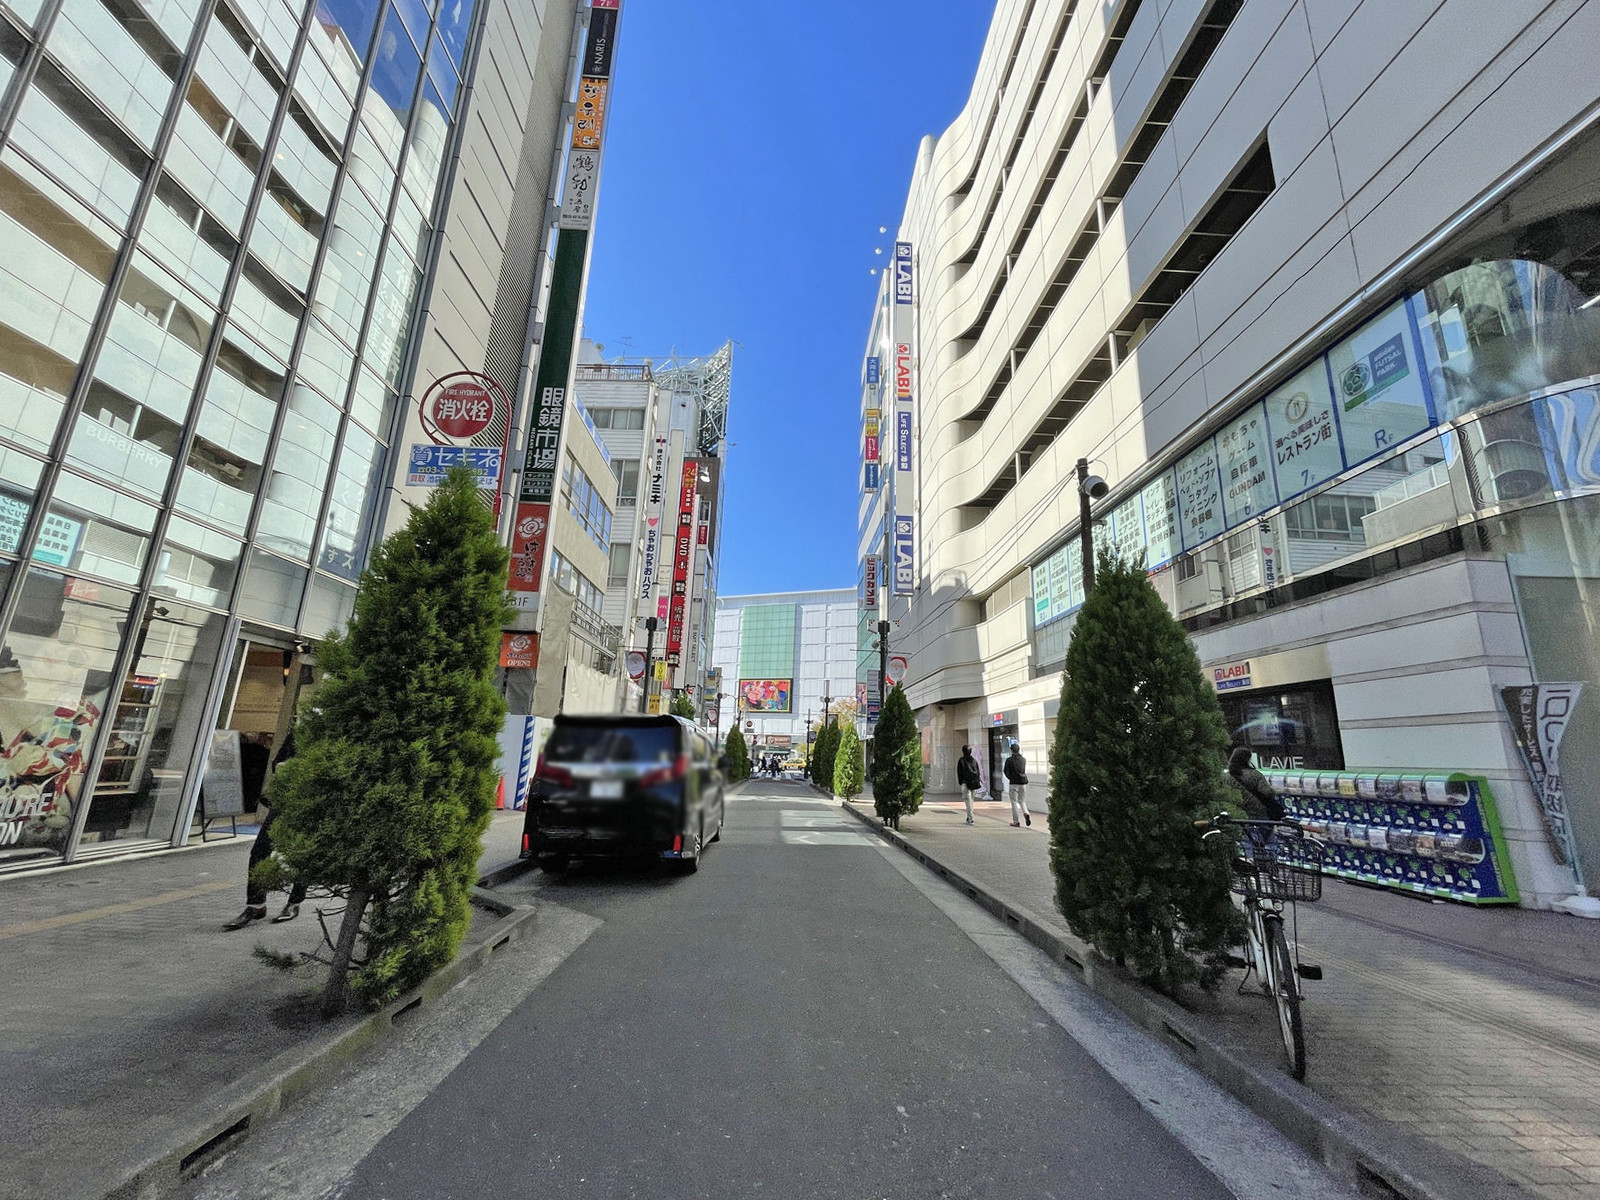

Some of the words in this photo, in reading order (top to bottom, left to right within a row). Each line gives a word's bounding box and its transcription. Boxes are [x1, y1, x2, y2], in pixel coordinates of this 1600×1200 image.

[594, 38, 606, 65] NARIS
[582, 135, 597, 145] 5F
[897, 261, 911, 300] LABI
[1375, 349, 1402, 369] FUTSAL
[1377, 363, 1396, 377] PARK
[445, 388, 459, 396] FIRE
[460, 389, 486, 397] HYDRANT
[437, 399, 490, 421] 消火栓
[532, 387, 564, 469] 眼鏡市場
[1223, 419, 1257, 448] おもちゃ
[86, 425, 164, 468] BURBERRY
[901, 429, 909, 455] SELECT
[1228, 440, 1256, 462] ゲーム
[1278, 422, 1332, 465] レストラン街
[435, 448, 498, 467] セキネ
[655, 449, 663, 472] 株式会社
[1180, 456, 1213, 484] リフォーム
[1230, 455, 1258, 480] 自転車
[650, 474, 662, 505] ナミキ
[1145, 475, 1172, 498] インテリア
[1189, 484, 1209, 503] コタツ
[1229, 471, 1266, 499] GUNDAM
[1184, 492, 1218, 519] ダイニング
[641, 530, 656, 599] ちゃおちゃおハウス
[897, 540, 912, 590] LABI
[1260, 757, 1304, 770] LAVIE
